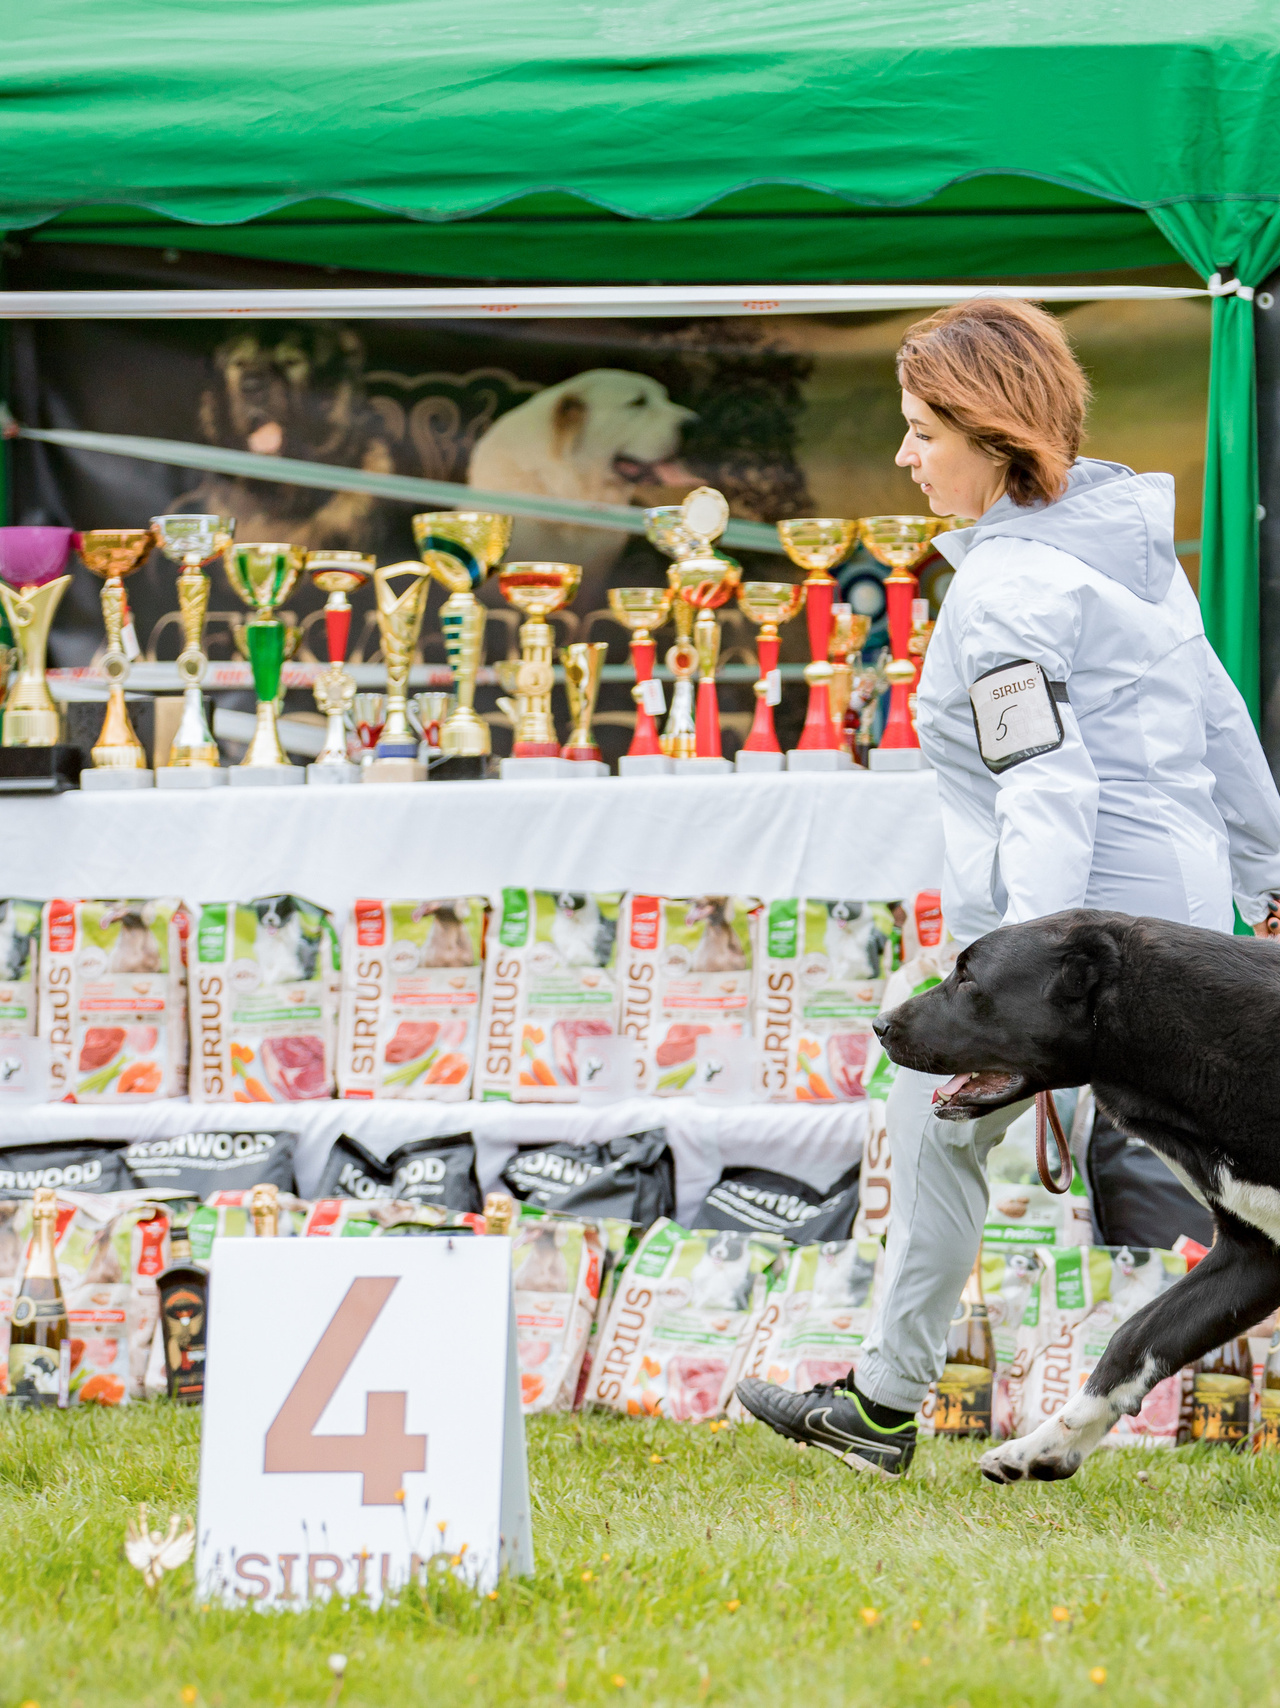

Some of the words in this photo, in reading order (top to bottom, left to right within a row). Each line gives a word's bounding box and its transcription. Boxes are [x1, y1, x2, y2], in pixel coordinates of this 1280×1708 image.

[992, 678, 1036, 701] SIRIUS
[995, 704, 1018, 741] 5
[200, 976, 225, 1095] SIRIUS
[351, 959, 384, 1074] SIRIUS
[486, 959, 522, 1075] SIRIUS
[263, 1275, 429, 1506] 4
[597, 1286, 653, 1400] SIRIUS
